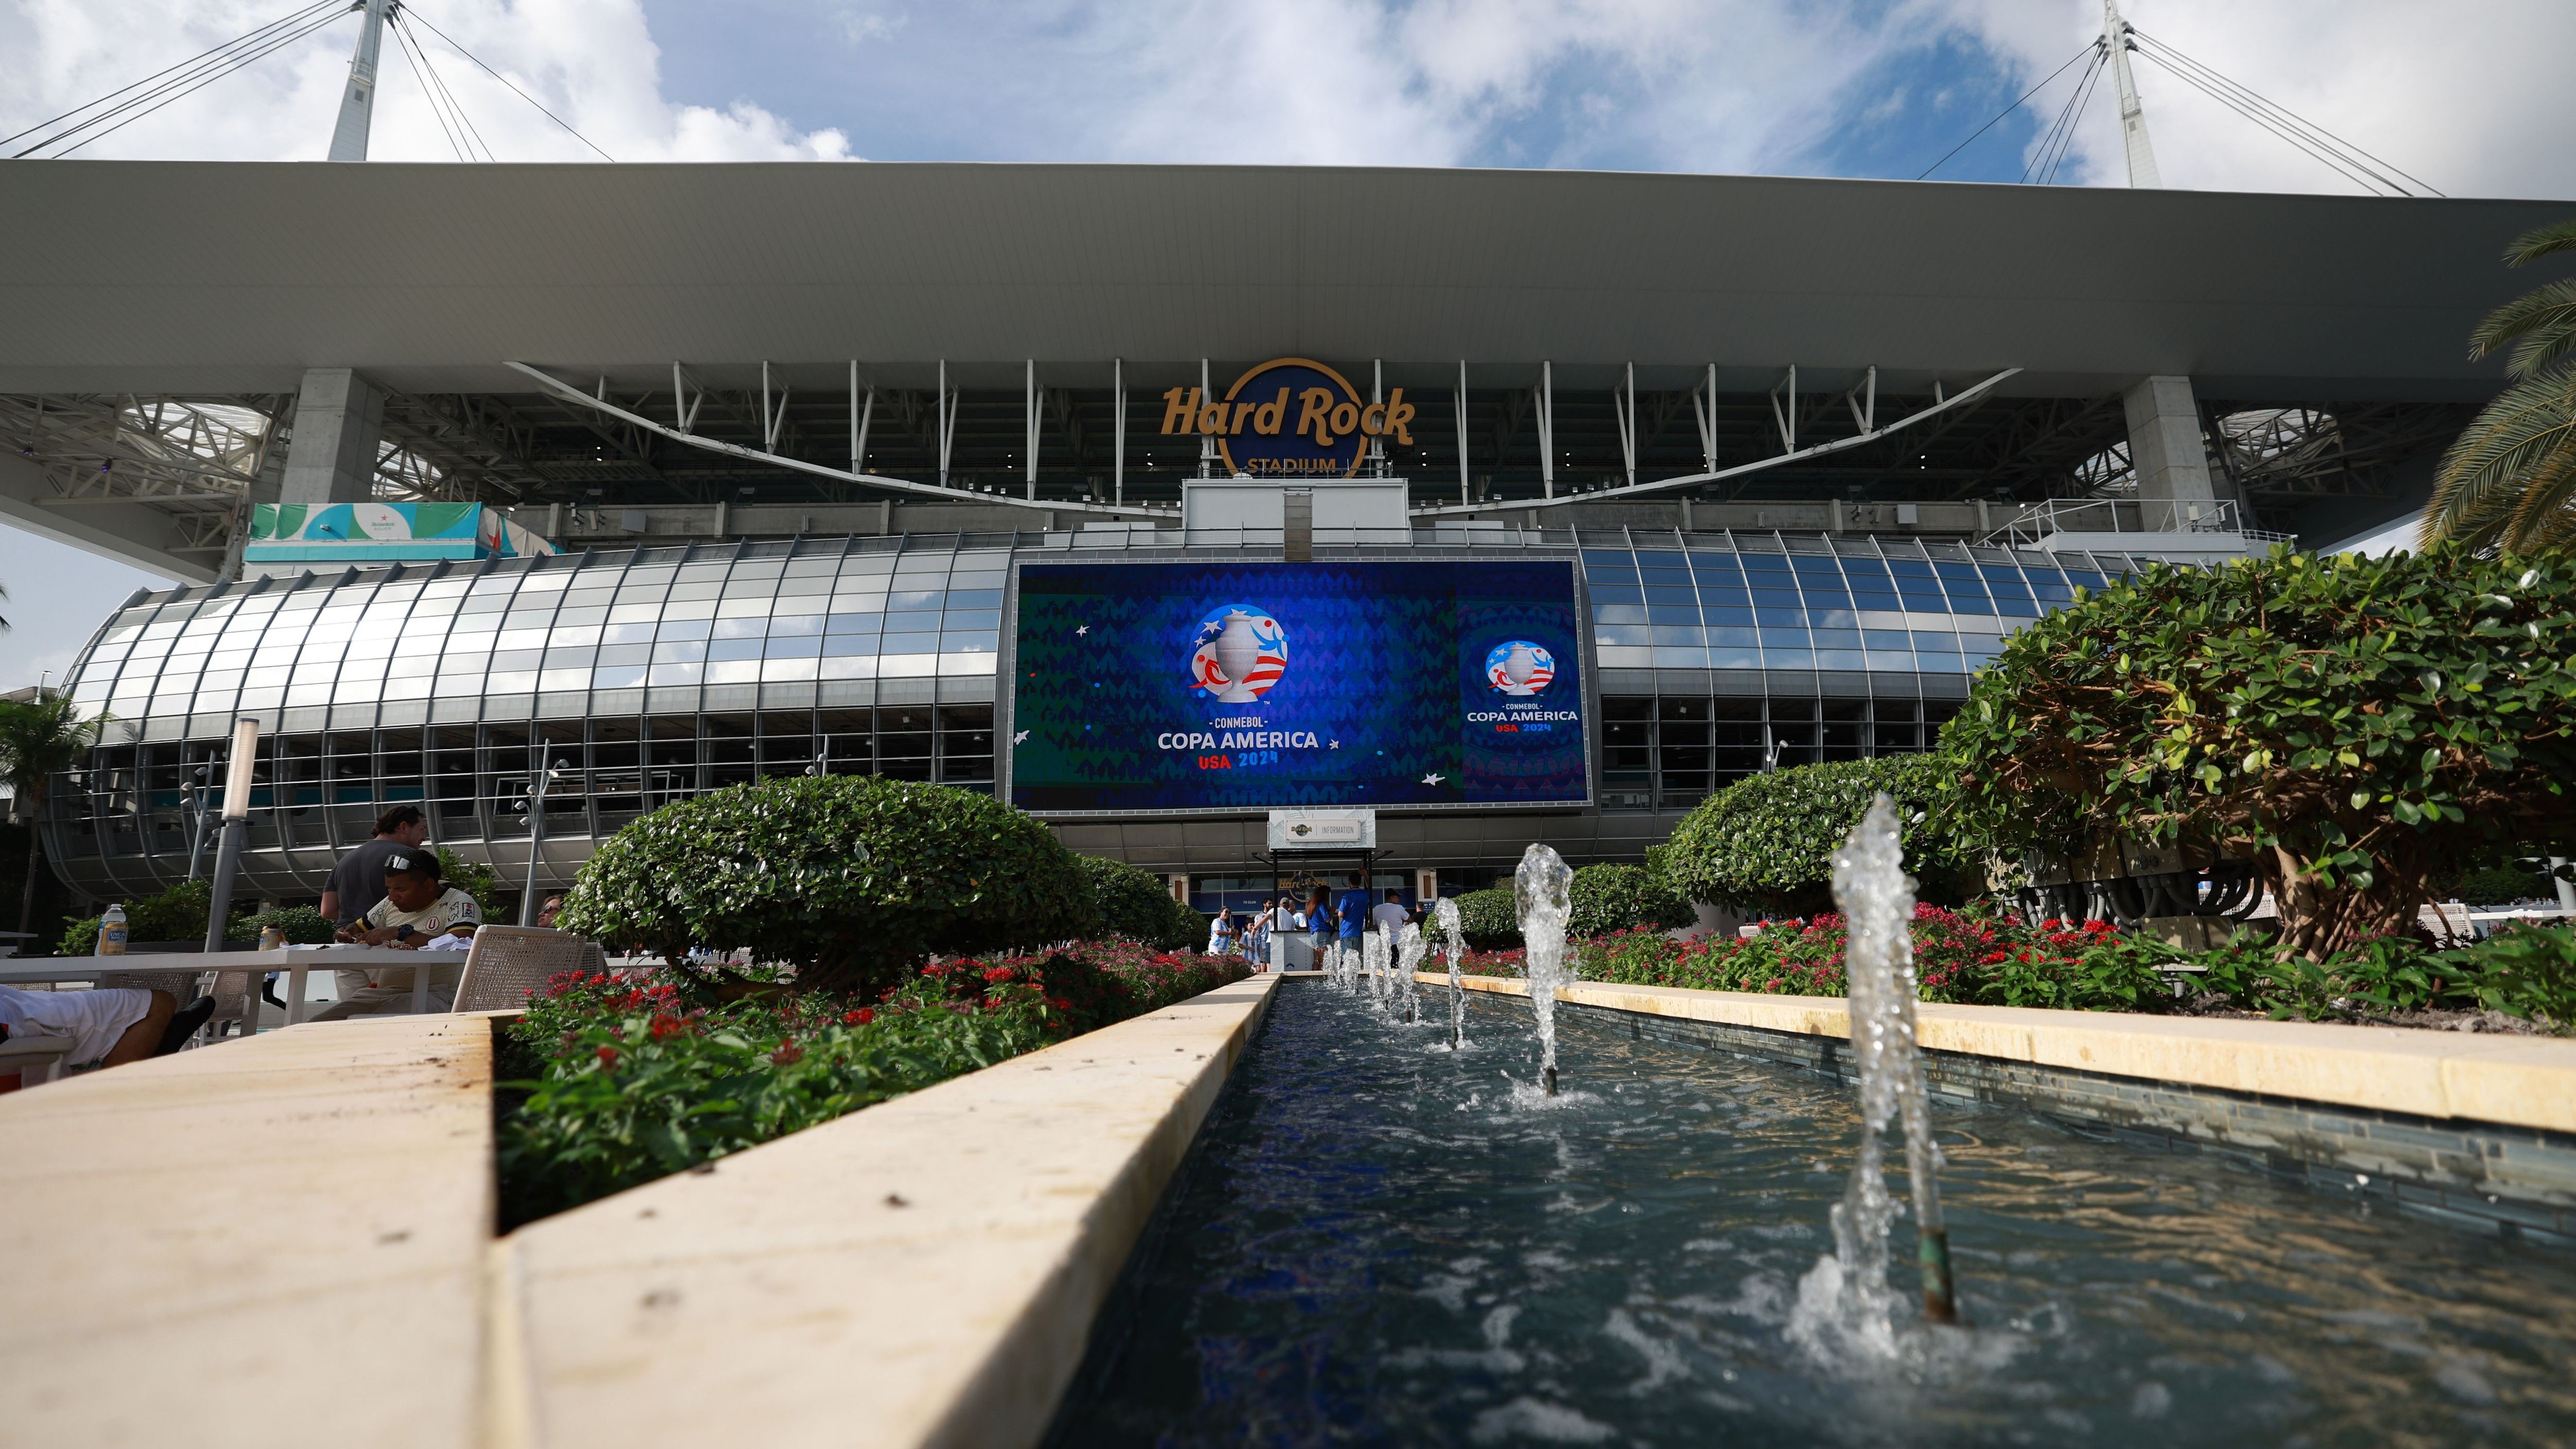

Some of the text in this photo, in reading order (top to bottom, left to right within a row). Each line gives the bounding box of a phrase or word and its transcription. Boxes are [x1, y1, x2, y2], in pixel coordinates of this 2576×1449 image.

[1161, 387, 1415, 446] Hard Rock
[1248, 458, 1336, 473] STADIUM
[1467, 711, 1578, 722] COPA AMERICA
[1495, 723, 1552, 732] USA 2024
[1158, 731, 1319, 749] COPA AMERICA
[1198, 750, 1278, 770] USA 2024
[429, 919, 436, 930] U
